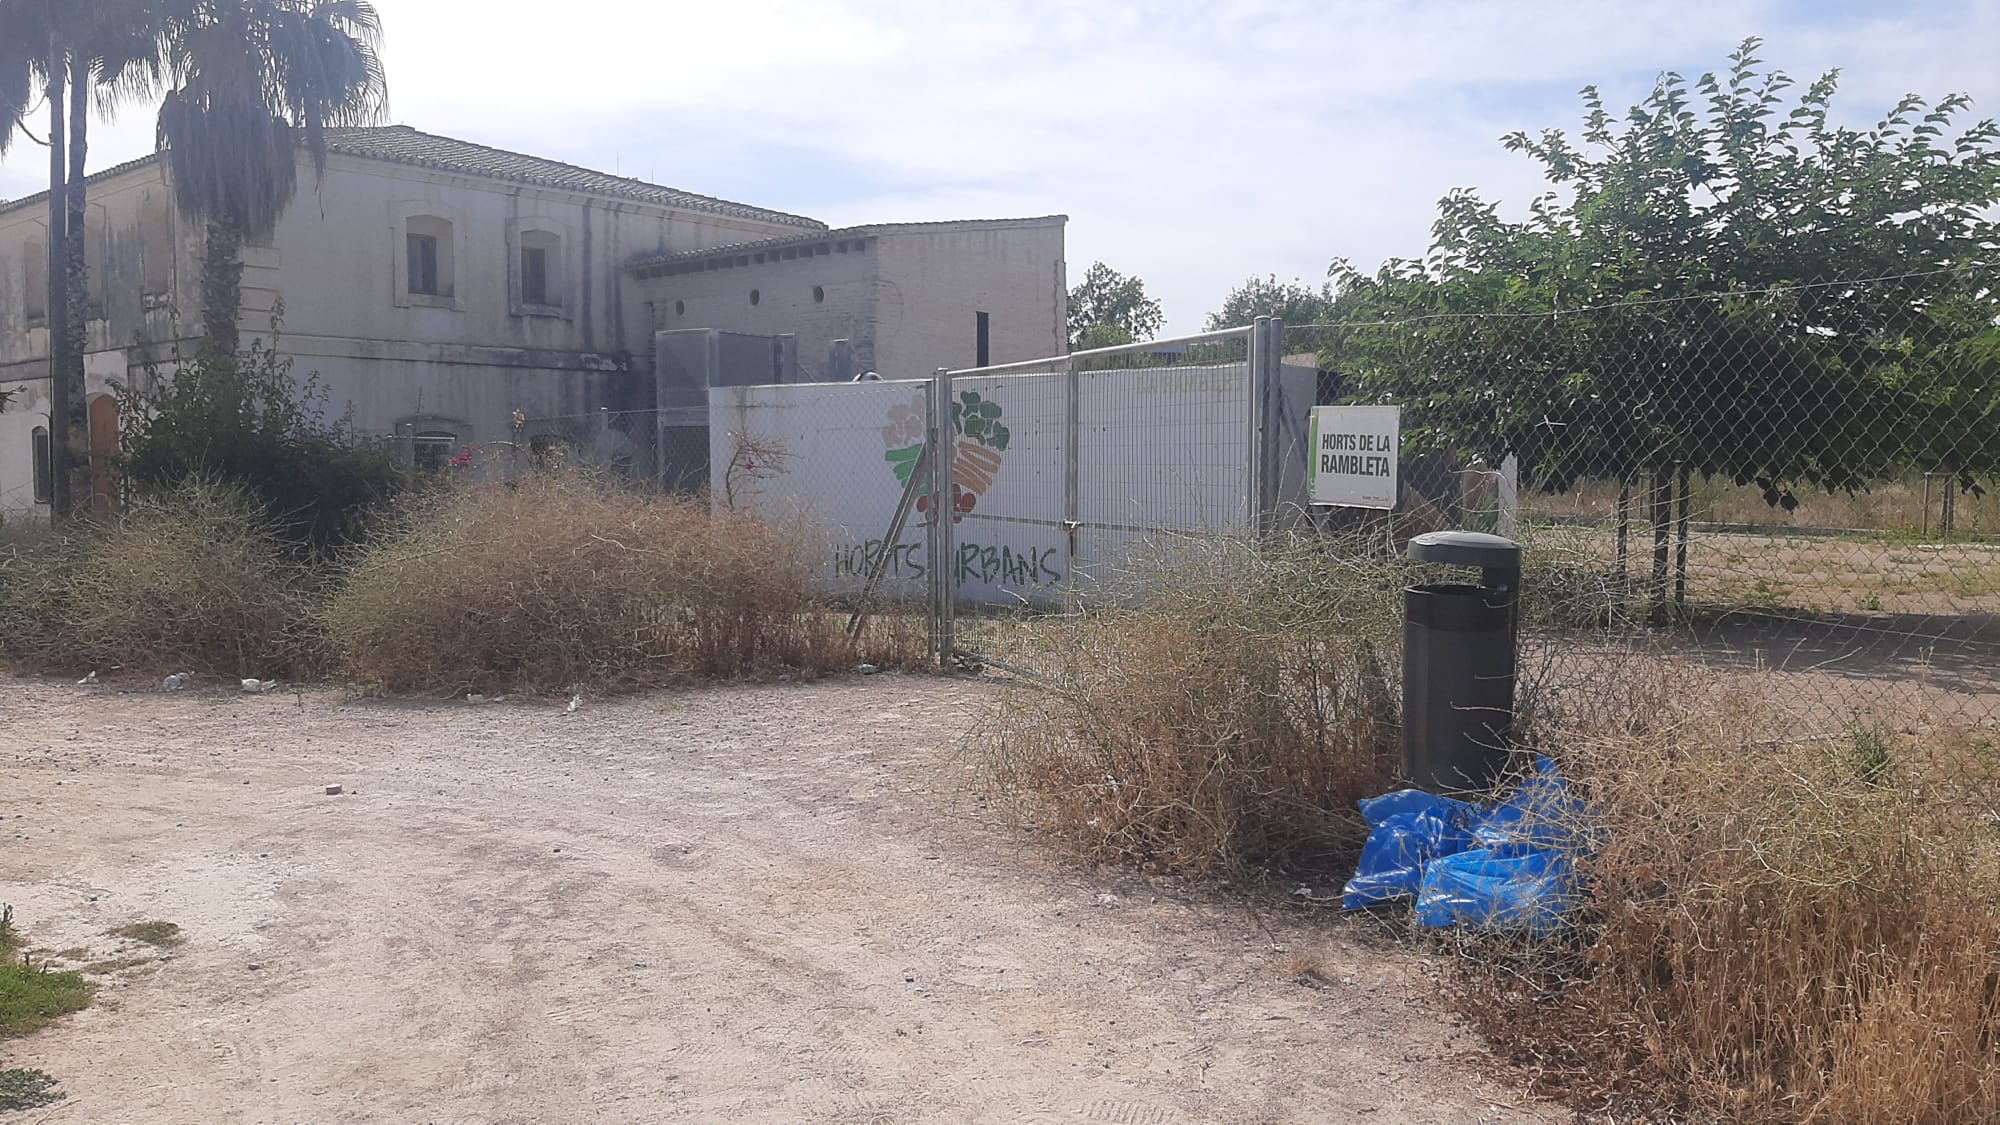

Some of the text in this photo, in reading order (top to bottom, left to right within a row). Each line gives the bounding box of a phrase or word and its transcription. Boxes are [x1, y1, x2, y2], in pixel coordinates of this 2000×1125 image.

[1322, 433, 1391, 452] HORTS DE LA
[1321, 454, 1390, 477] RAMBLETA
[835, 539, 925, 580] HORTS
